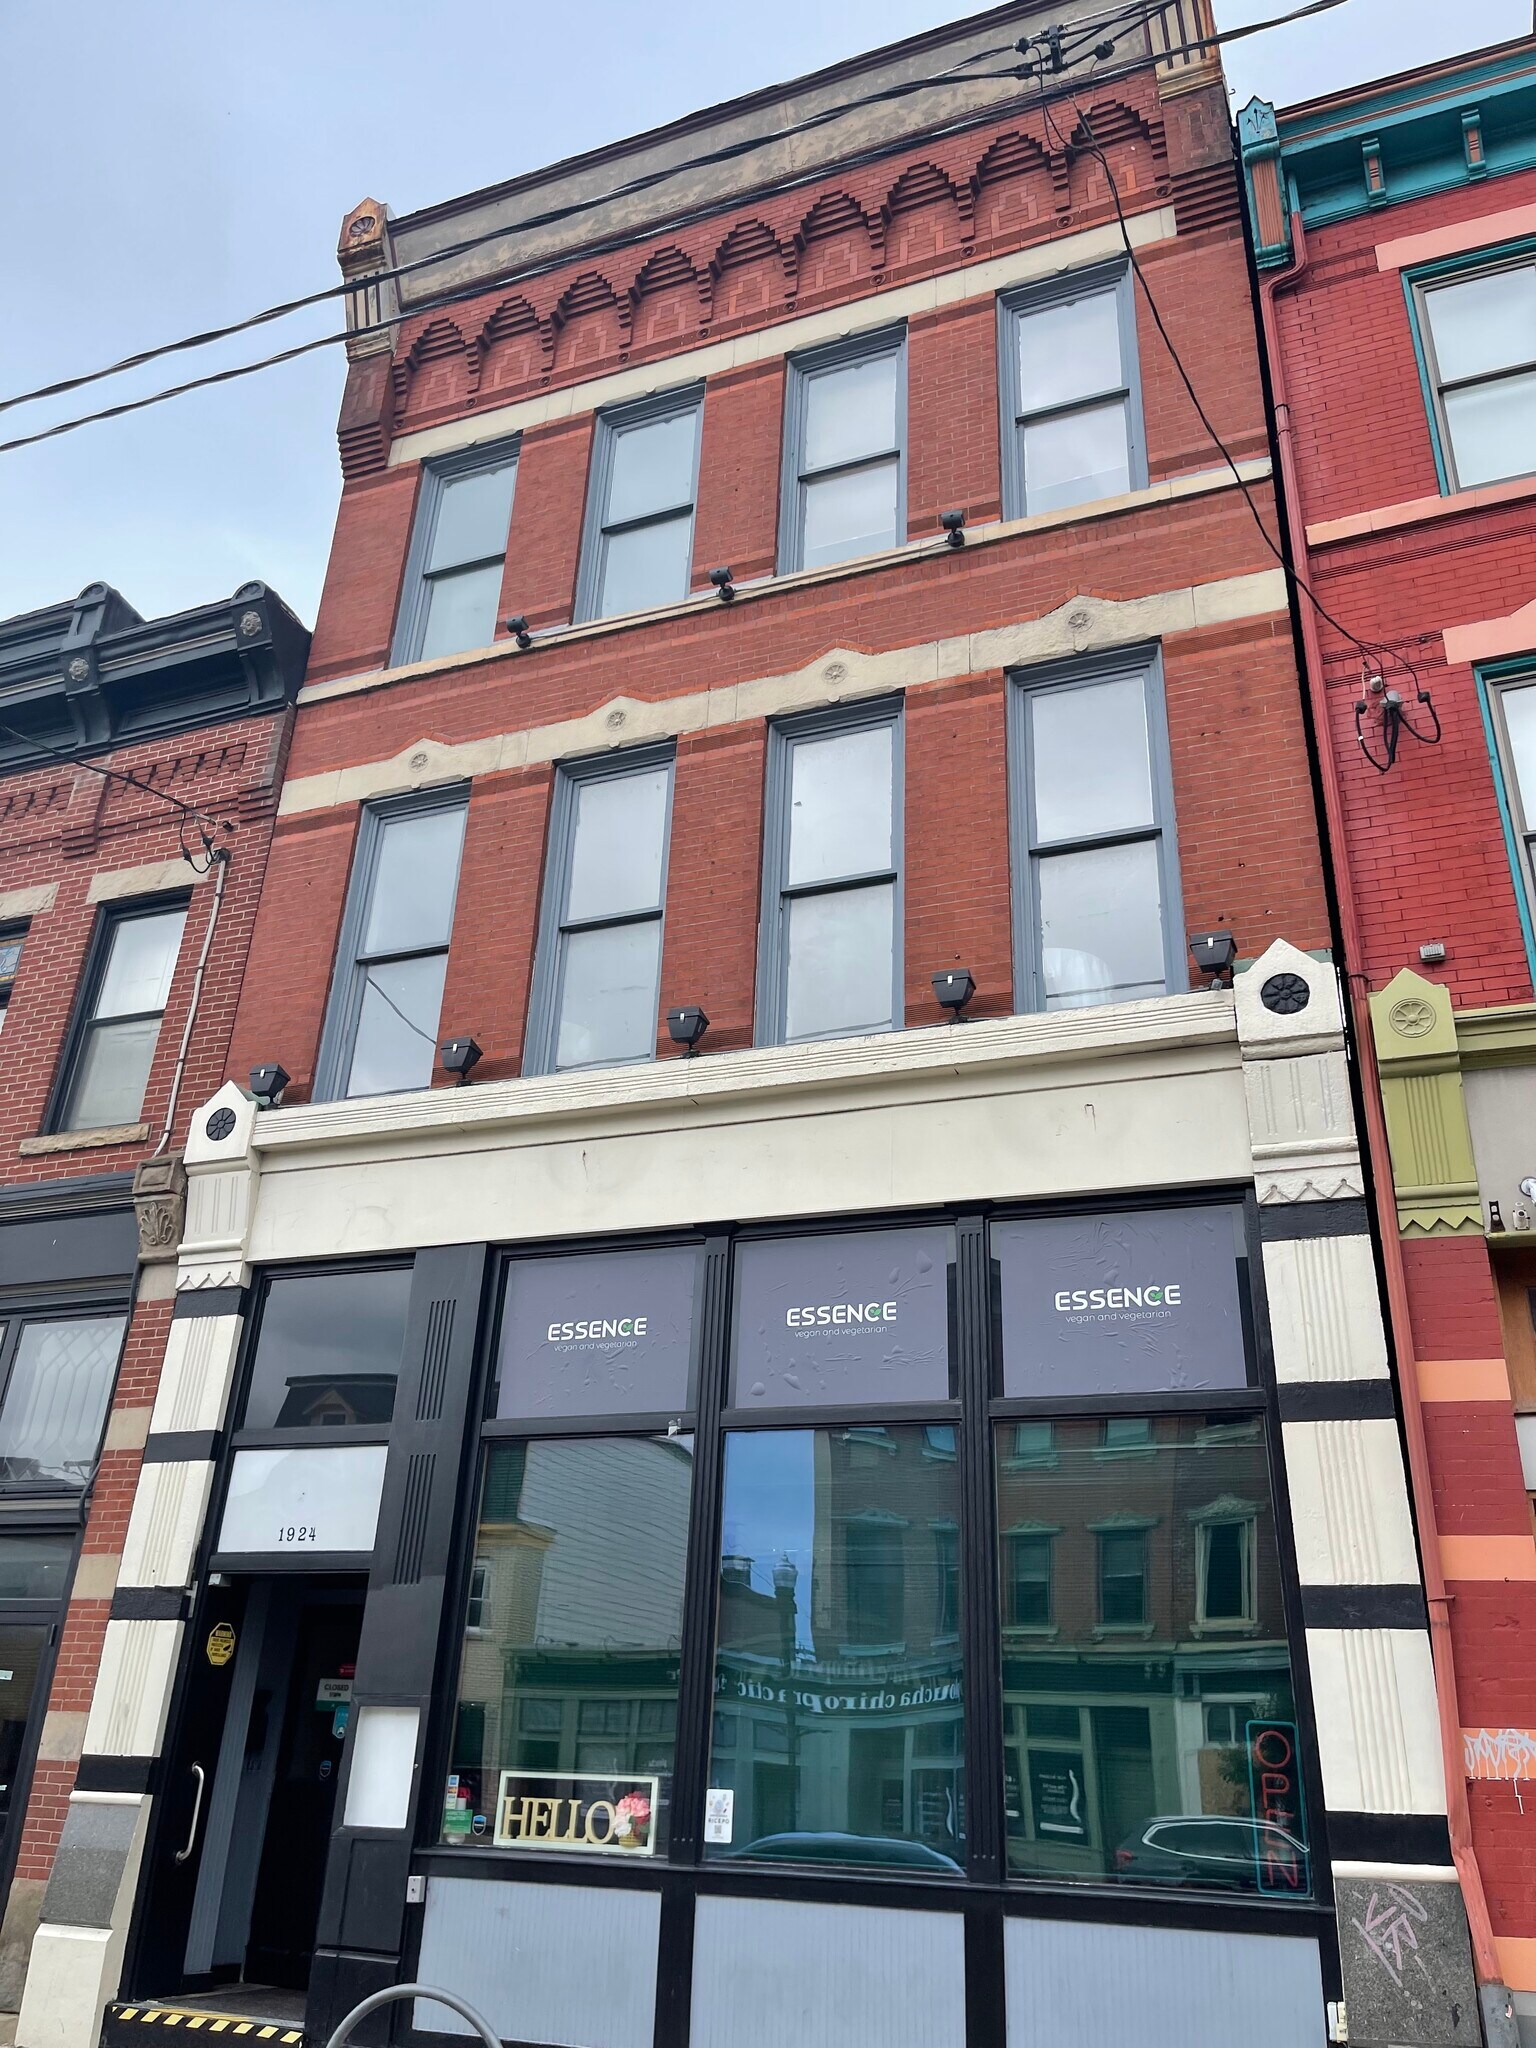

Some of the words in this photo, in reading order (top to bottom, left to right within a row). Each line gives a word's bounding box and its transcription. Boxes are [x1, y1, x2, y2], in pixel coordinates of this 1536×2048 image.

[1055, 1284, 1182, 1312] ESSENCE
[786, 1301, 897, 1327] ESSENCE
[1065, 1313, 1096, 1324] vegan
[1097, 1312, 1117, 1321] and
[1118, 1309, 1172, 1321] vegetarian
[547, 1317, 648, 1341] ESSENCE
[794, 1329, 821, 1339] vegan
[822, 1327, 840, 1336] and
[841, 1325, 888, 1336] vegetarian
[553, 1342, 578, 1353] vegan
[579, 1341, 595, 1351] and
[596, 1339, 637, 1351] vegetarian
[278, 1526, 317, 1542] 1924
[324, 1683, 350, 1692] CLOSED
[1255, 1730, 1298, 1888] OPEN
[501, 1796, 616, 1844] HELLO
